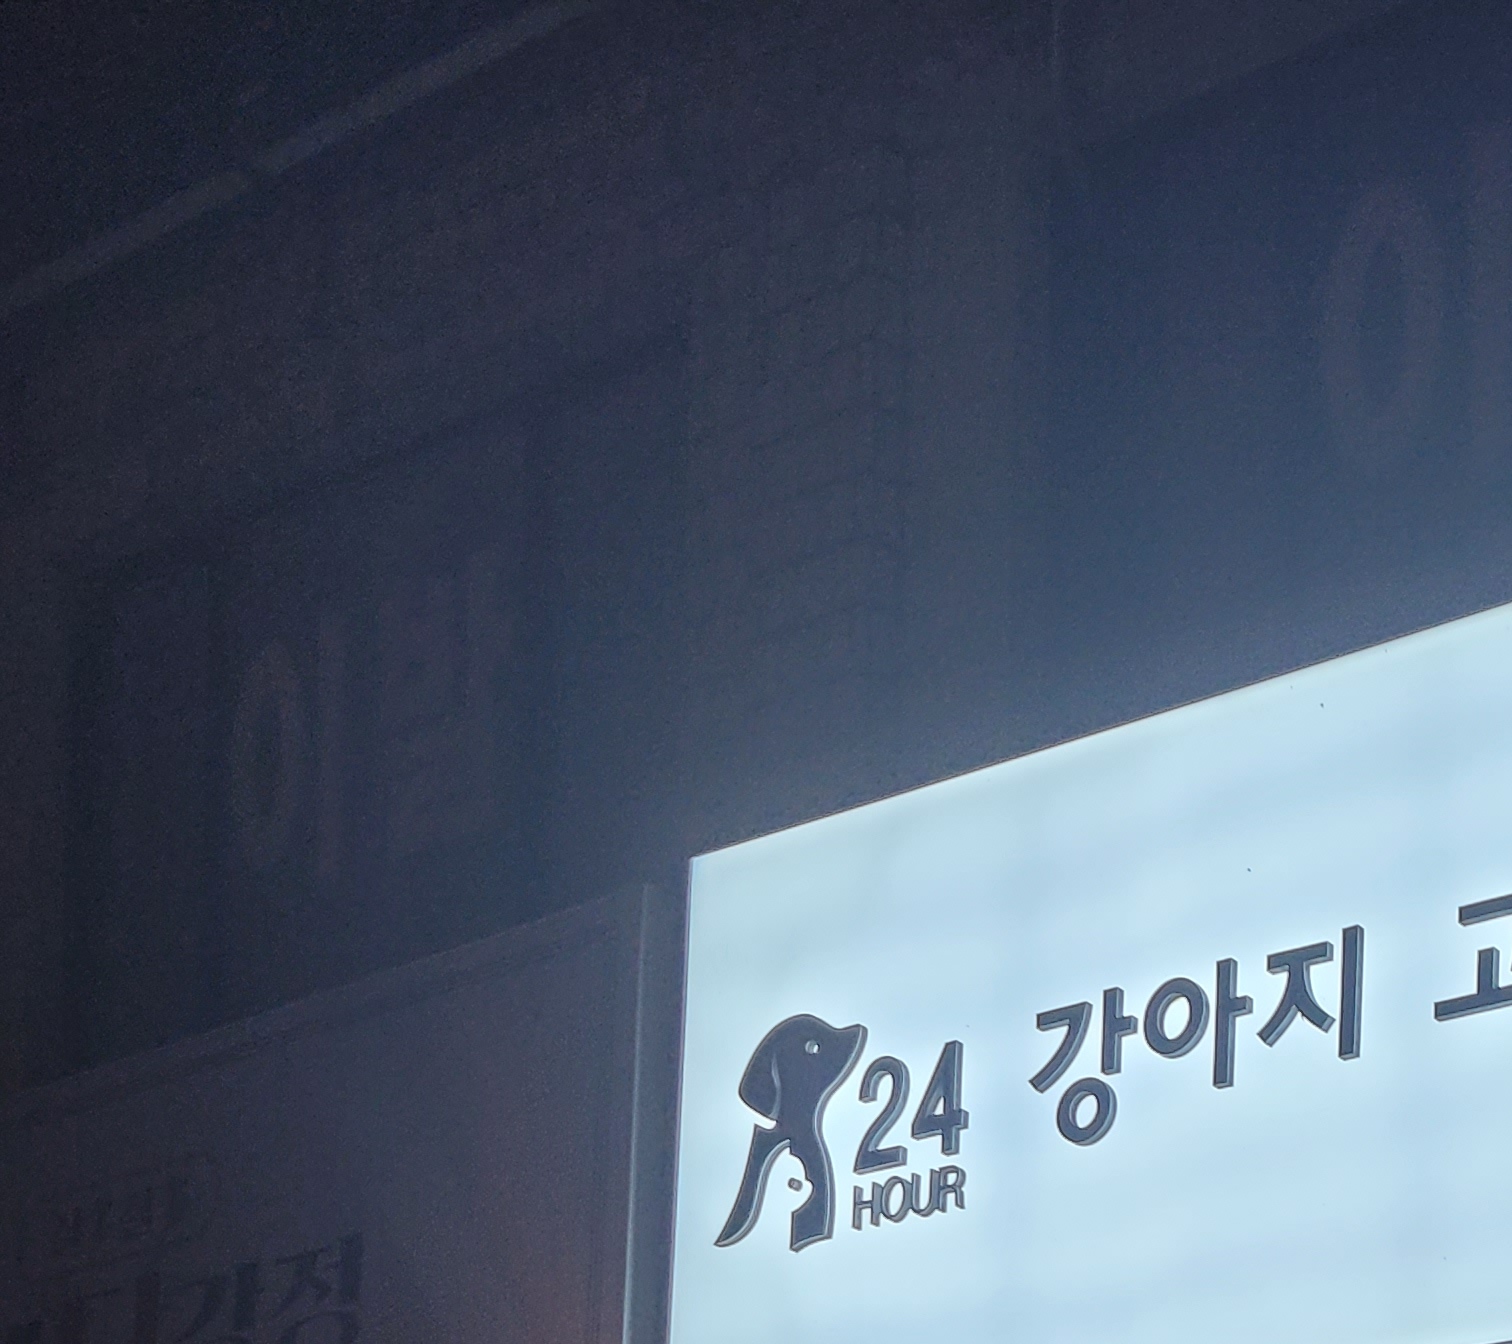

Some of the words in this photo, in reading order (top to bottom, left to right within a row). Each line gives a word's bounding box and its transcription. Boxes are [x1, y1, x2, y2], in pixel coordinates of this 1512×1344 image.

[1029, 924, 1364, 1148] 강아지
[855, 1038, 968, 1171] 24
[850, 1164, 966, 1231] HOUR
